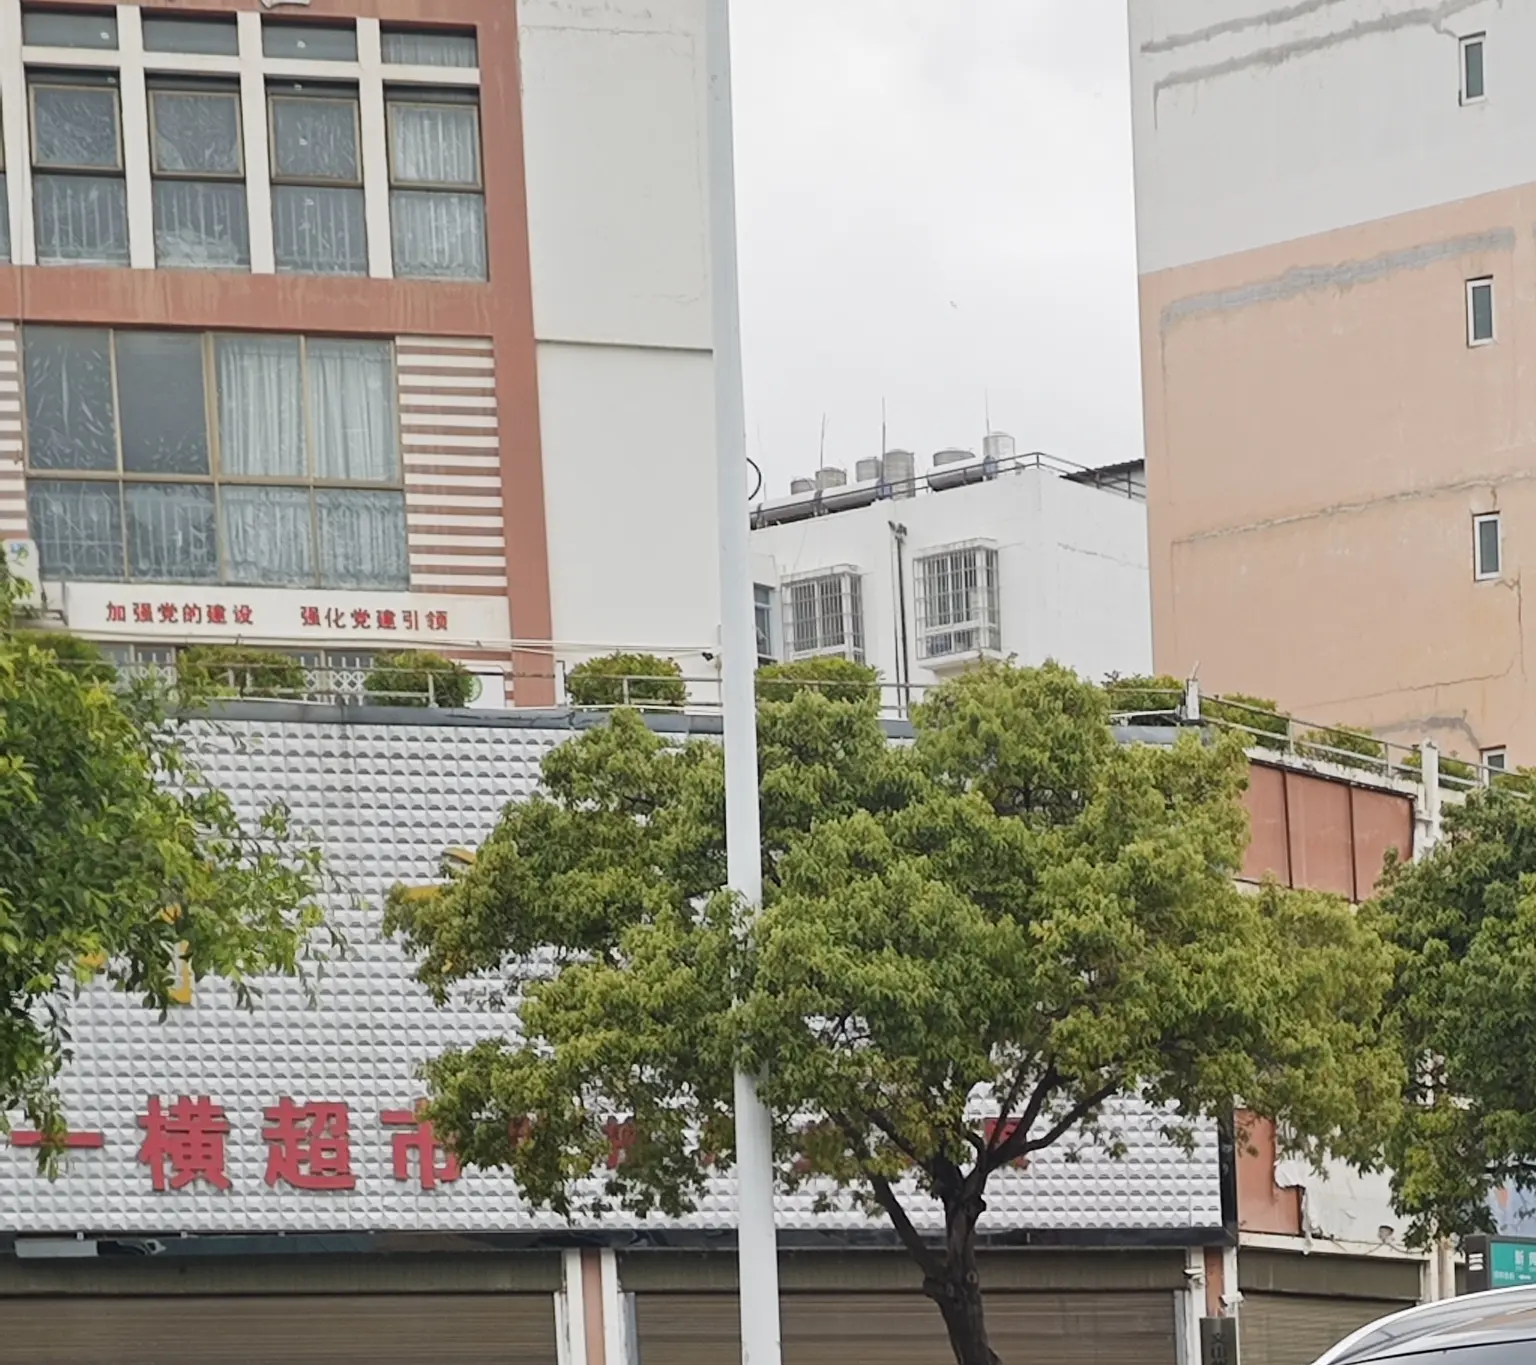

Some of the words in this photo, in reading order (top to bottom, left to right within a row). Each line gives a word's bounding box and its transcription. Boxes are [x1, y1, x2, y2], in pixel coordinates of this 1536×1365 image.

[106, 600, 254, 626] 加强党的建设
[300, 605, 448, 631] 强化党建引领
